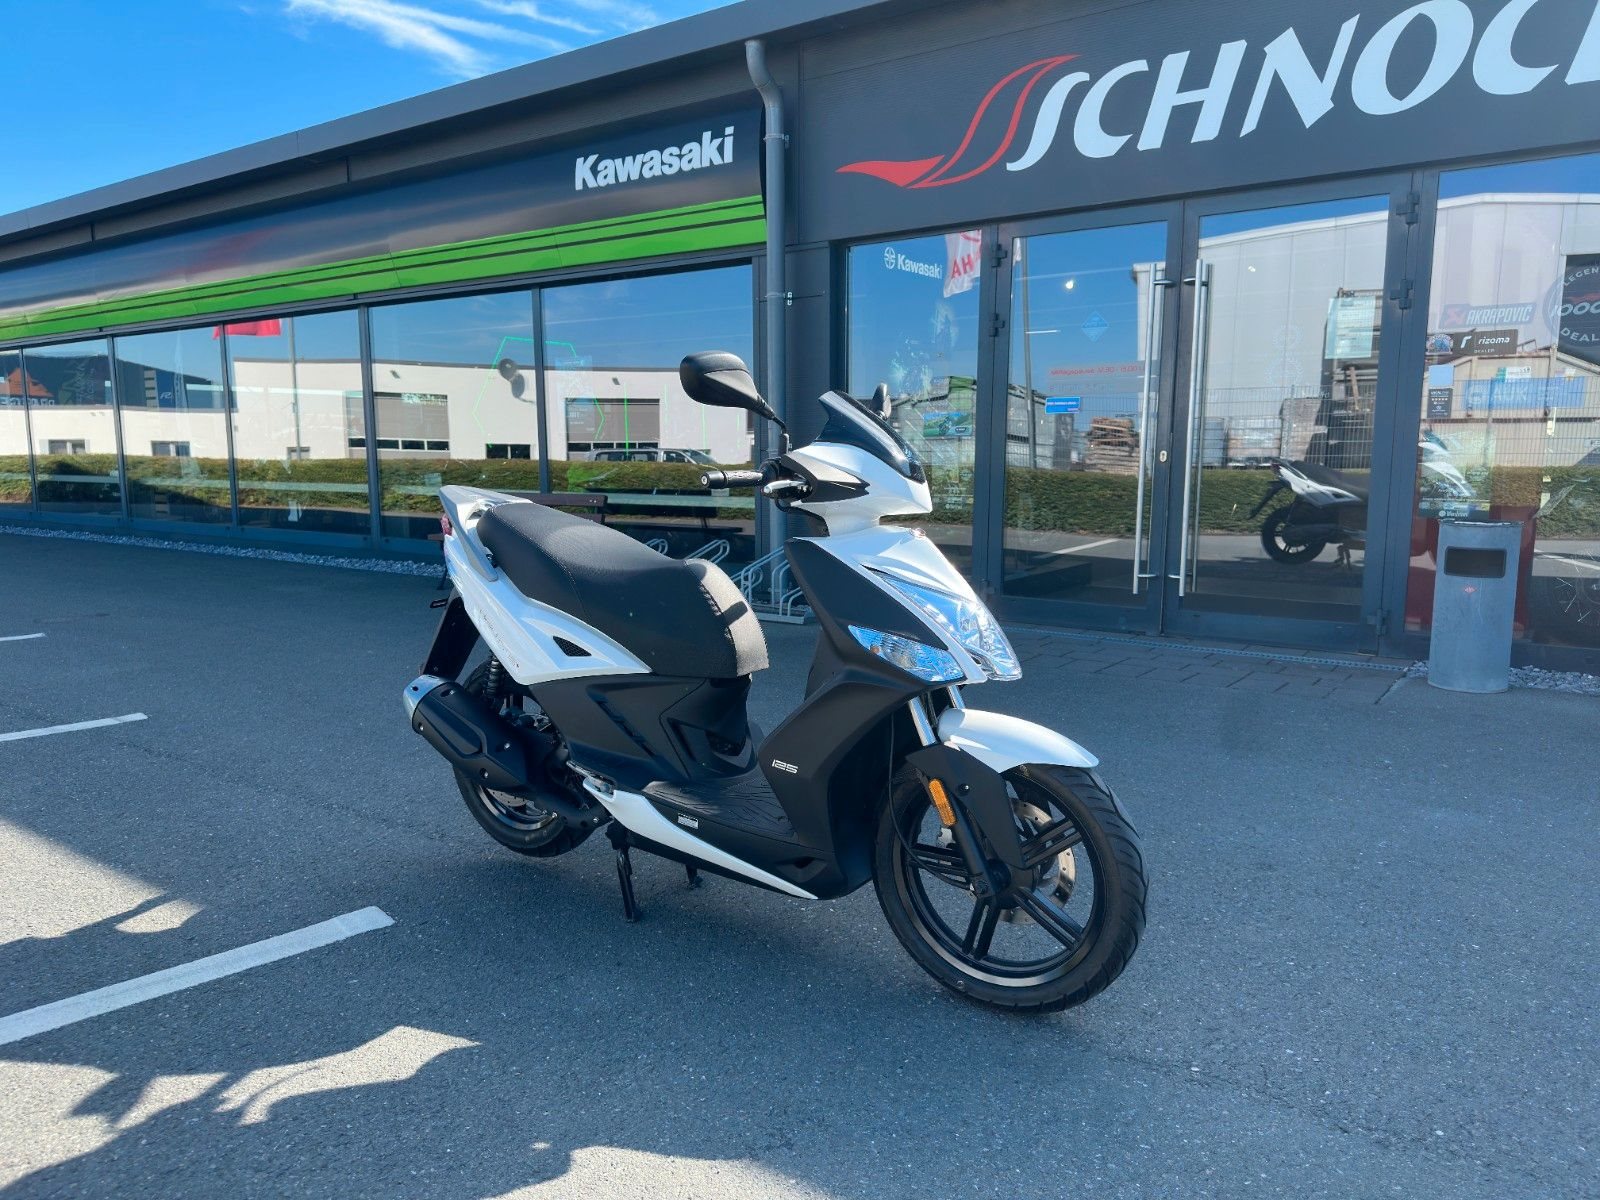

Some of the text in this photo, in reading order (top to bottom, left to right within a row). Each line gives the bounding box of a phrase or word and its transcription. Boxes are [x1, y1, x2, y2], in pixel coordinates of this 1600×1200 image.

[575, 126, 734, 191] Kawasaki
[897, 253, 943, 279] Kawasaki
[1478, 336, 1510, 345] rizoma
[772, 759, 798, 774] 125
